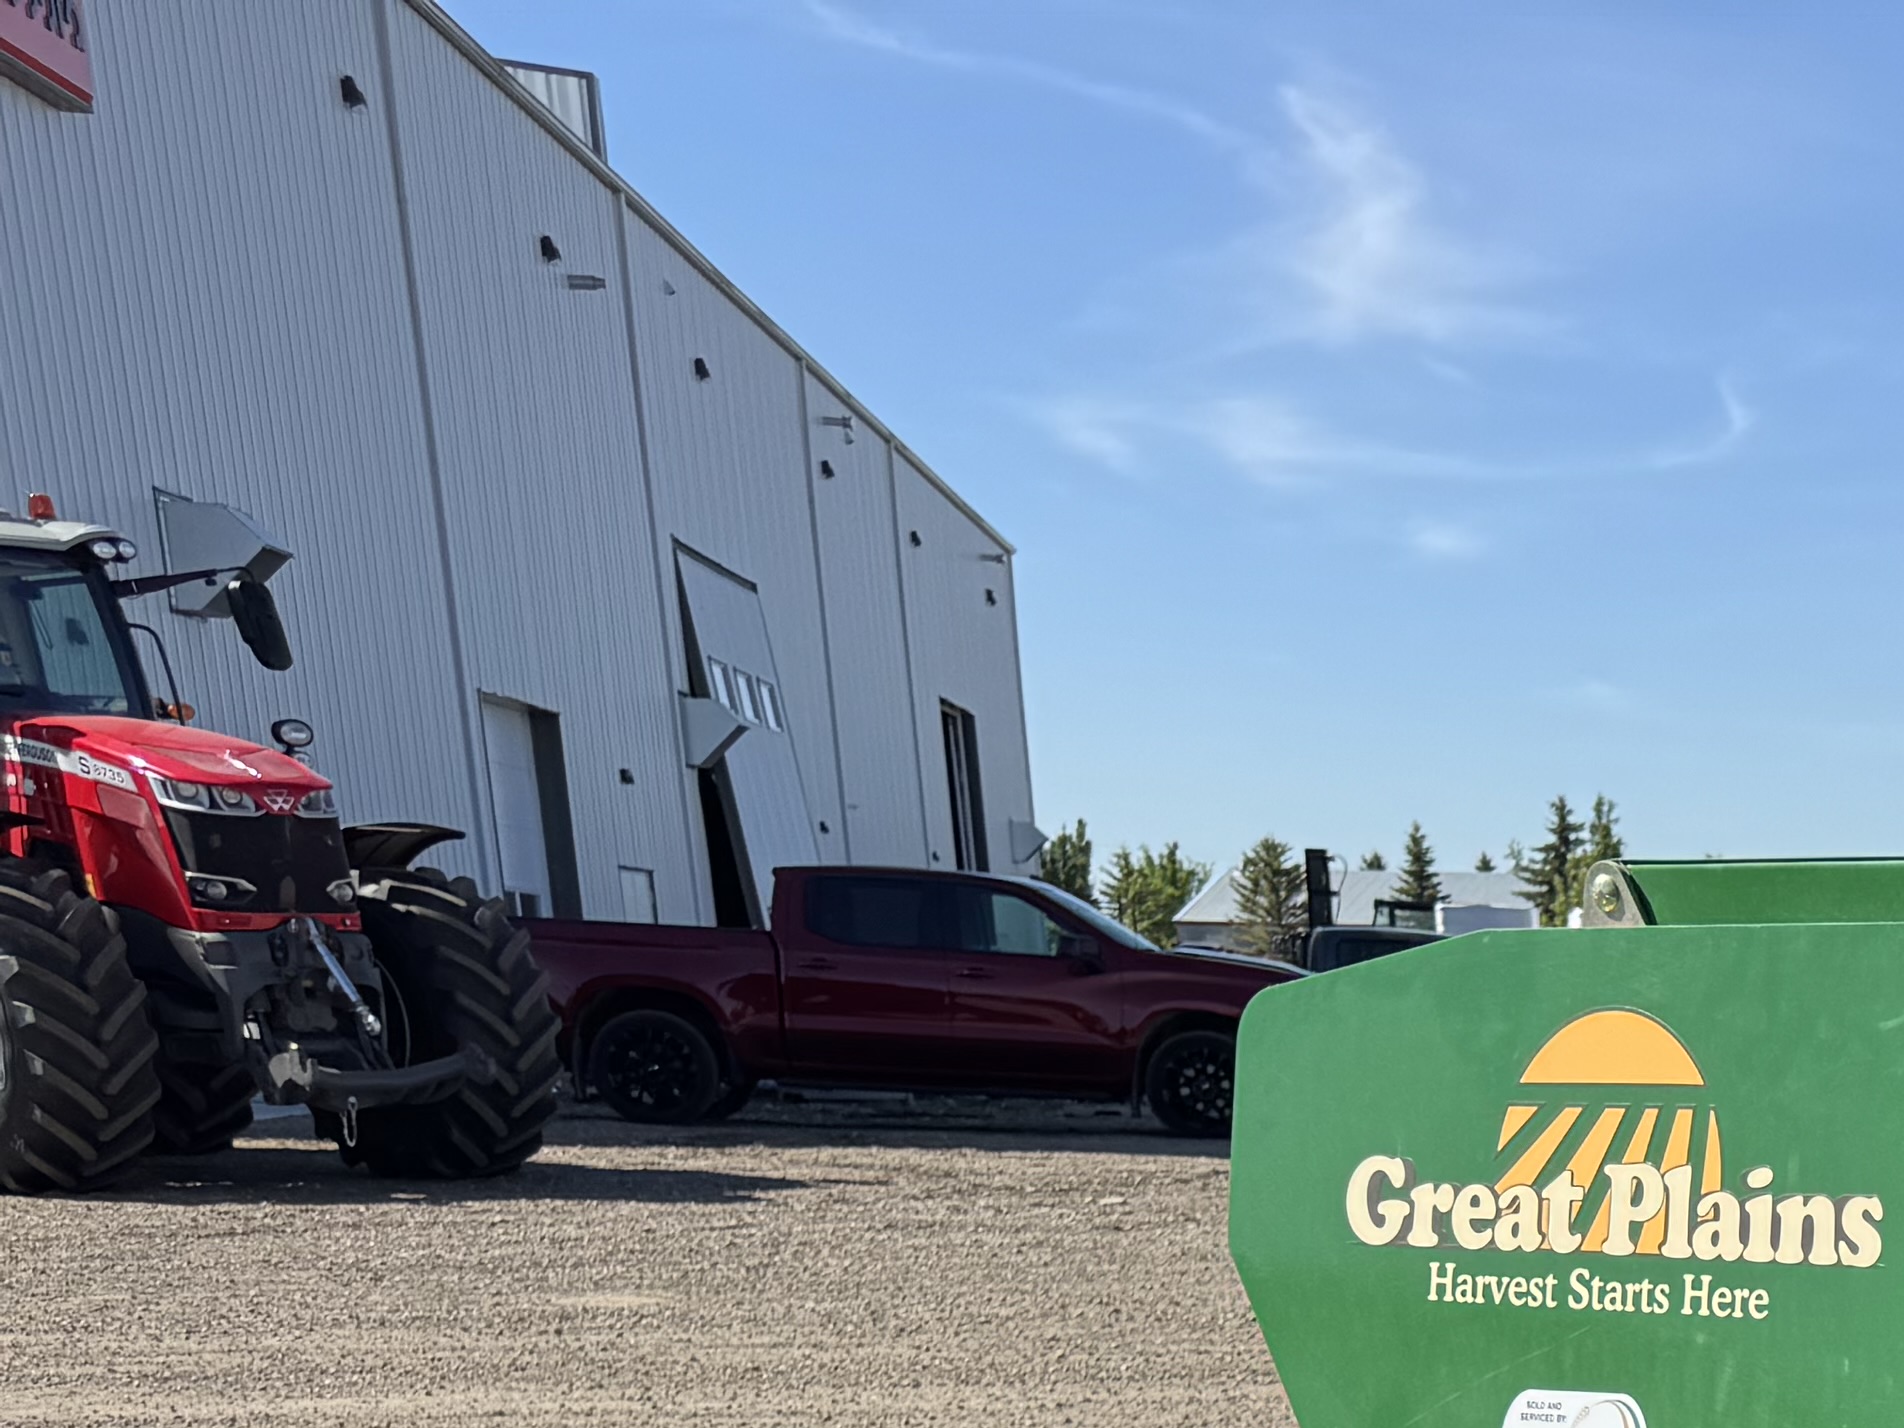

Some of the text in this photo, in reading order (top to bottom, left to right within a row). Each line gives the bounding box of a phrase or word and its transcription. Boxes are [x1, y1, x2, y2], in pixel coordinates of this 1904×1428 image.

[1345, 1155, 1883, 1268] Great Plains
[1427, 1261, 1770, 1320] Harvest Starts Here
